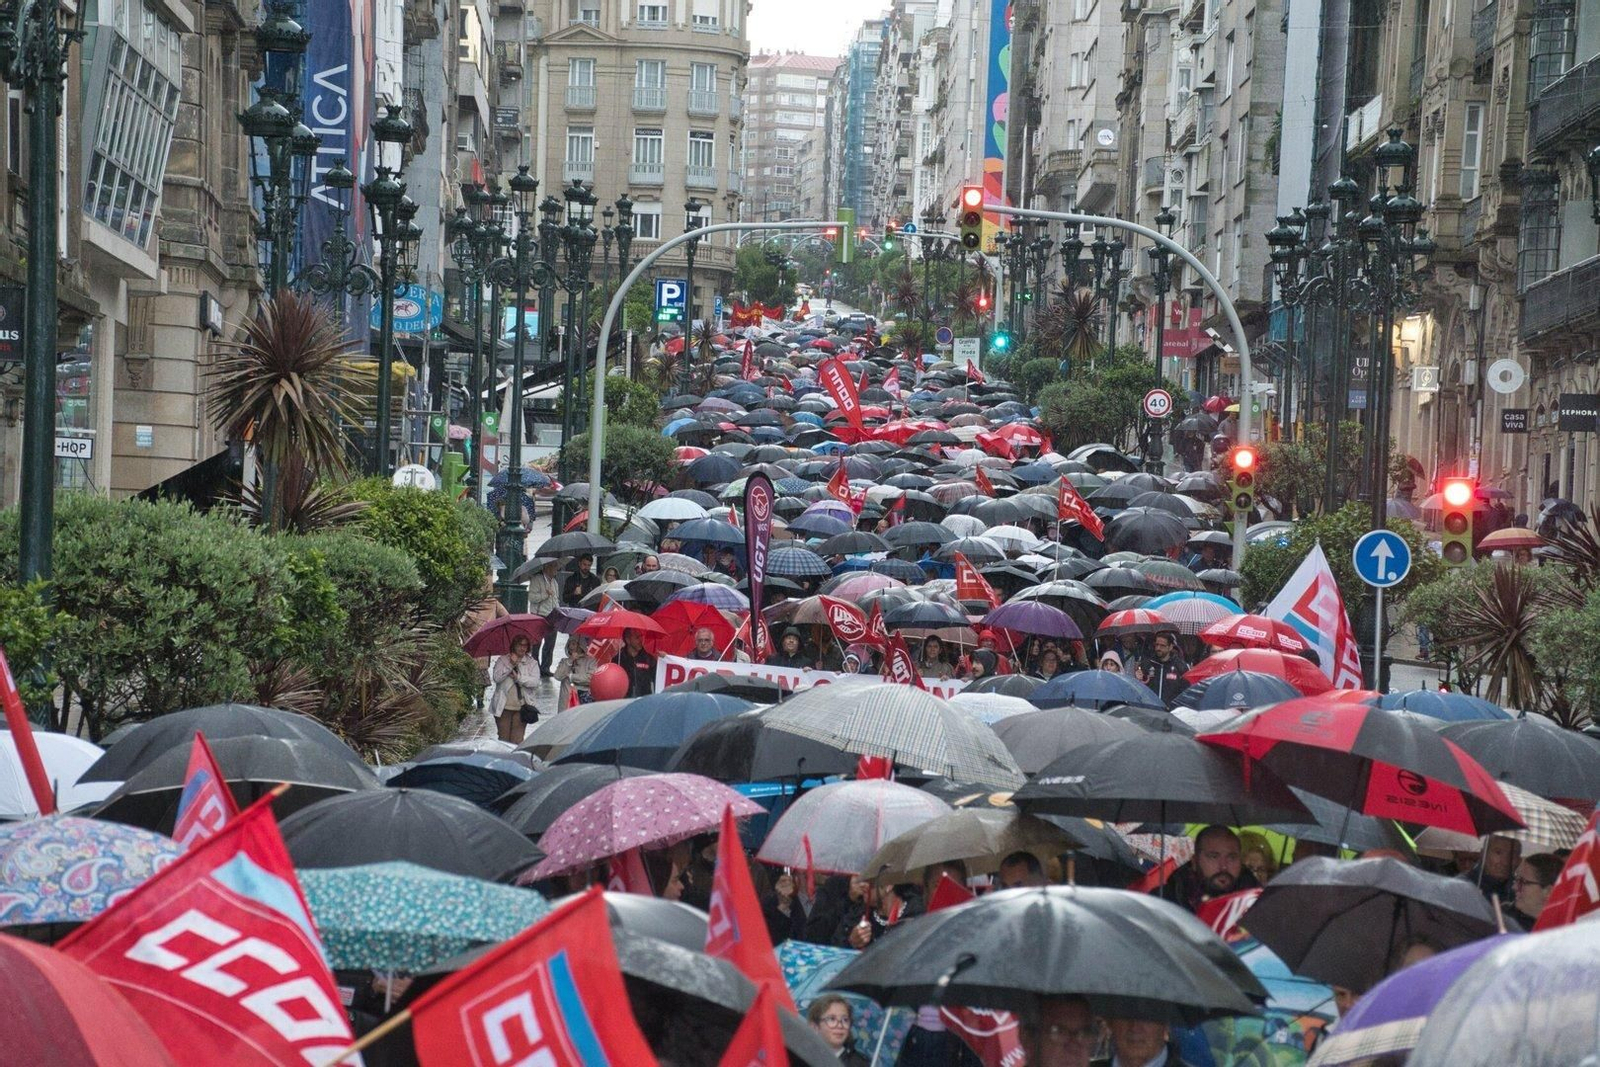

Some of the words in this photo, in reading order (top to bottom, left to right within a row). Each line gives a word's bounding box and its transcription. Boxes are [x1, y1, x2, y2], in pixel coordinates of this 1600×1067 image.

[662, 283, 681, 306] P
[0, 330, 20, 341] us
[1150, 398, 1166, 407] 40
[1505, 421, 1524, 429] viva
[57, 442, 87, 453] -HOP
[753, 535, 766, 582] UGT
